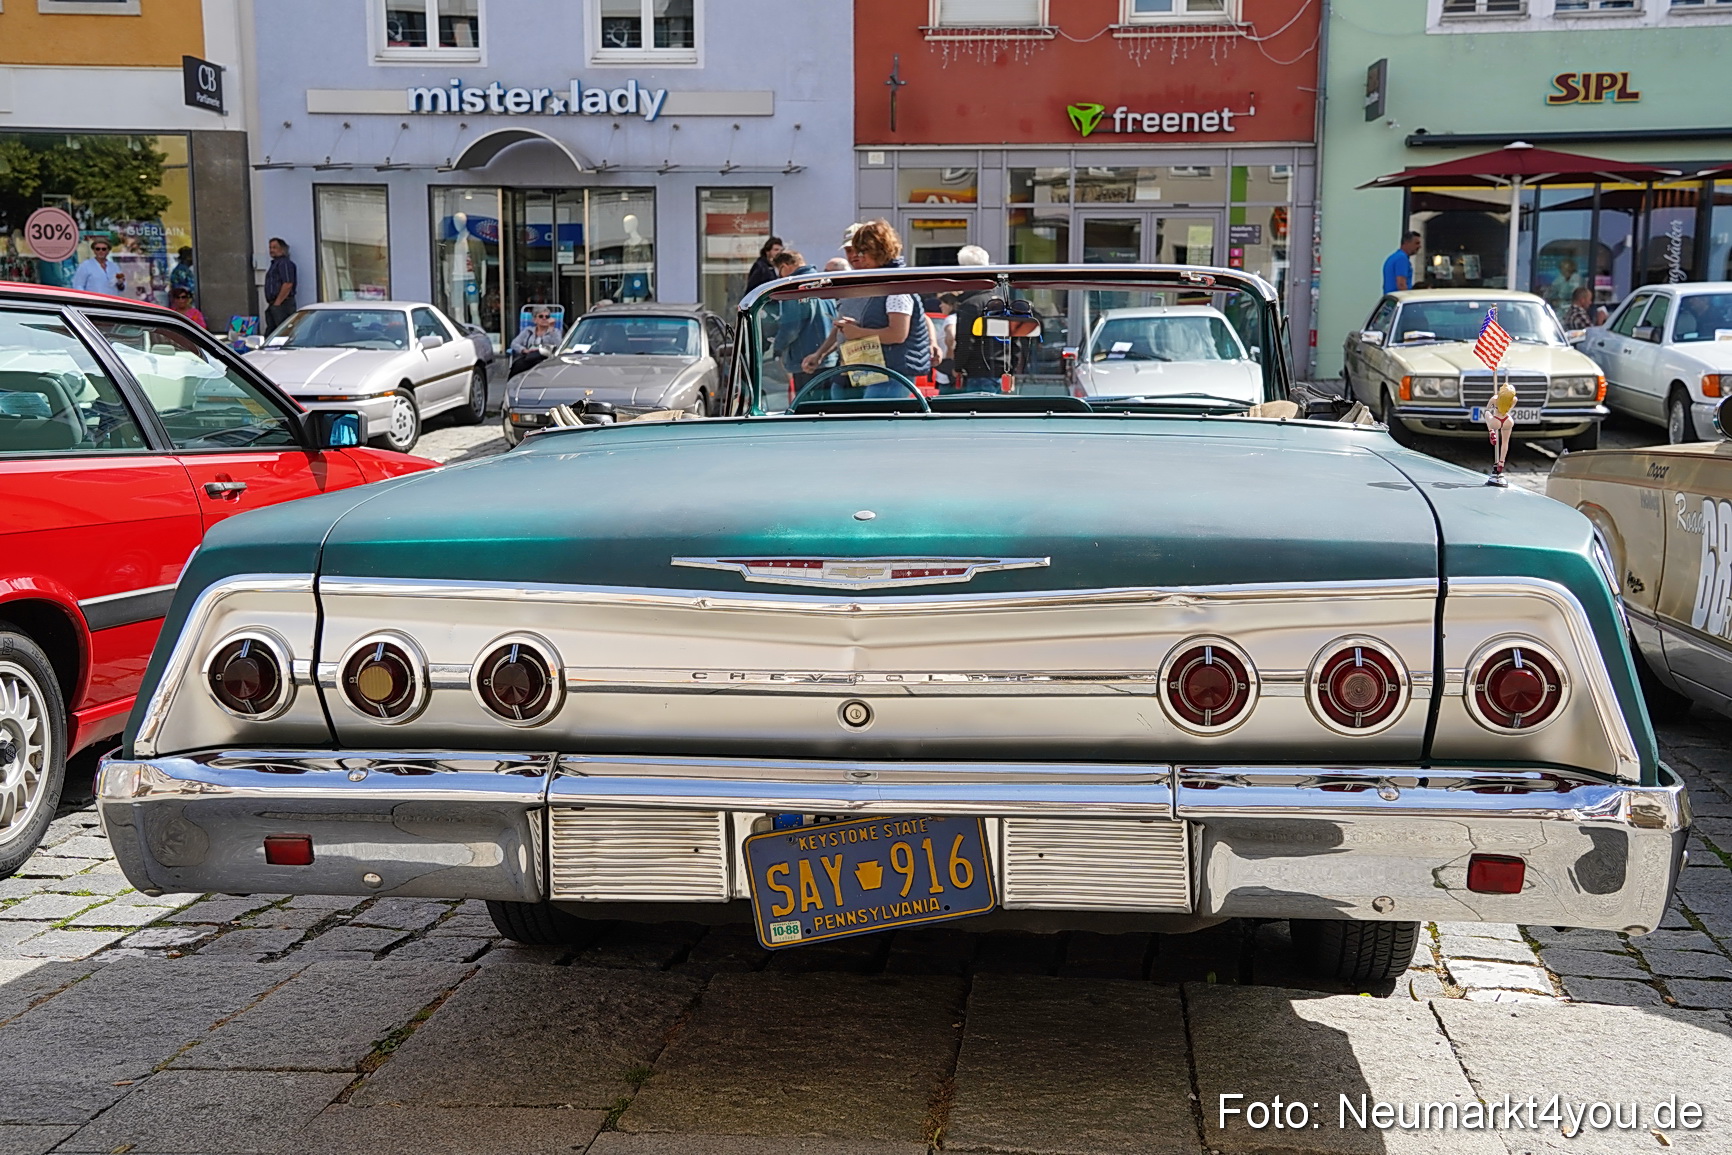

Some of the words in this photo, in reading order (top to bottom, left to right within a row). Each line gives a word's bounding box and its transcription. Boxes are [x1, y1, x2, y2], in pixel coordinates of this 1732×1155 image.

[198, 64, 217, 92] CB
[1546, 72, 1641, 104] SIPL
[408, 78, 552, 113] mister
[569, 78, 667, 121] lady
[1113, 106, 1235, 132] freenet
[31, 223, 73, 241] 30%
[127, 226, 185, 236] GUERLAIN
[691, 671, 1029, 683] CHEVROLET
[800, 825, 878, 851] KEYSTONE
[883, 818, 928, 838] STATE
[766, 854, 843, 917] SAY
[890, 833, 974, 898] 916
[814, 897, 941, 931] PENNSYLVANIA
[772, 925, 800, 937] 10-88
